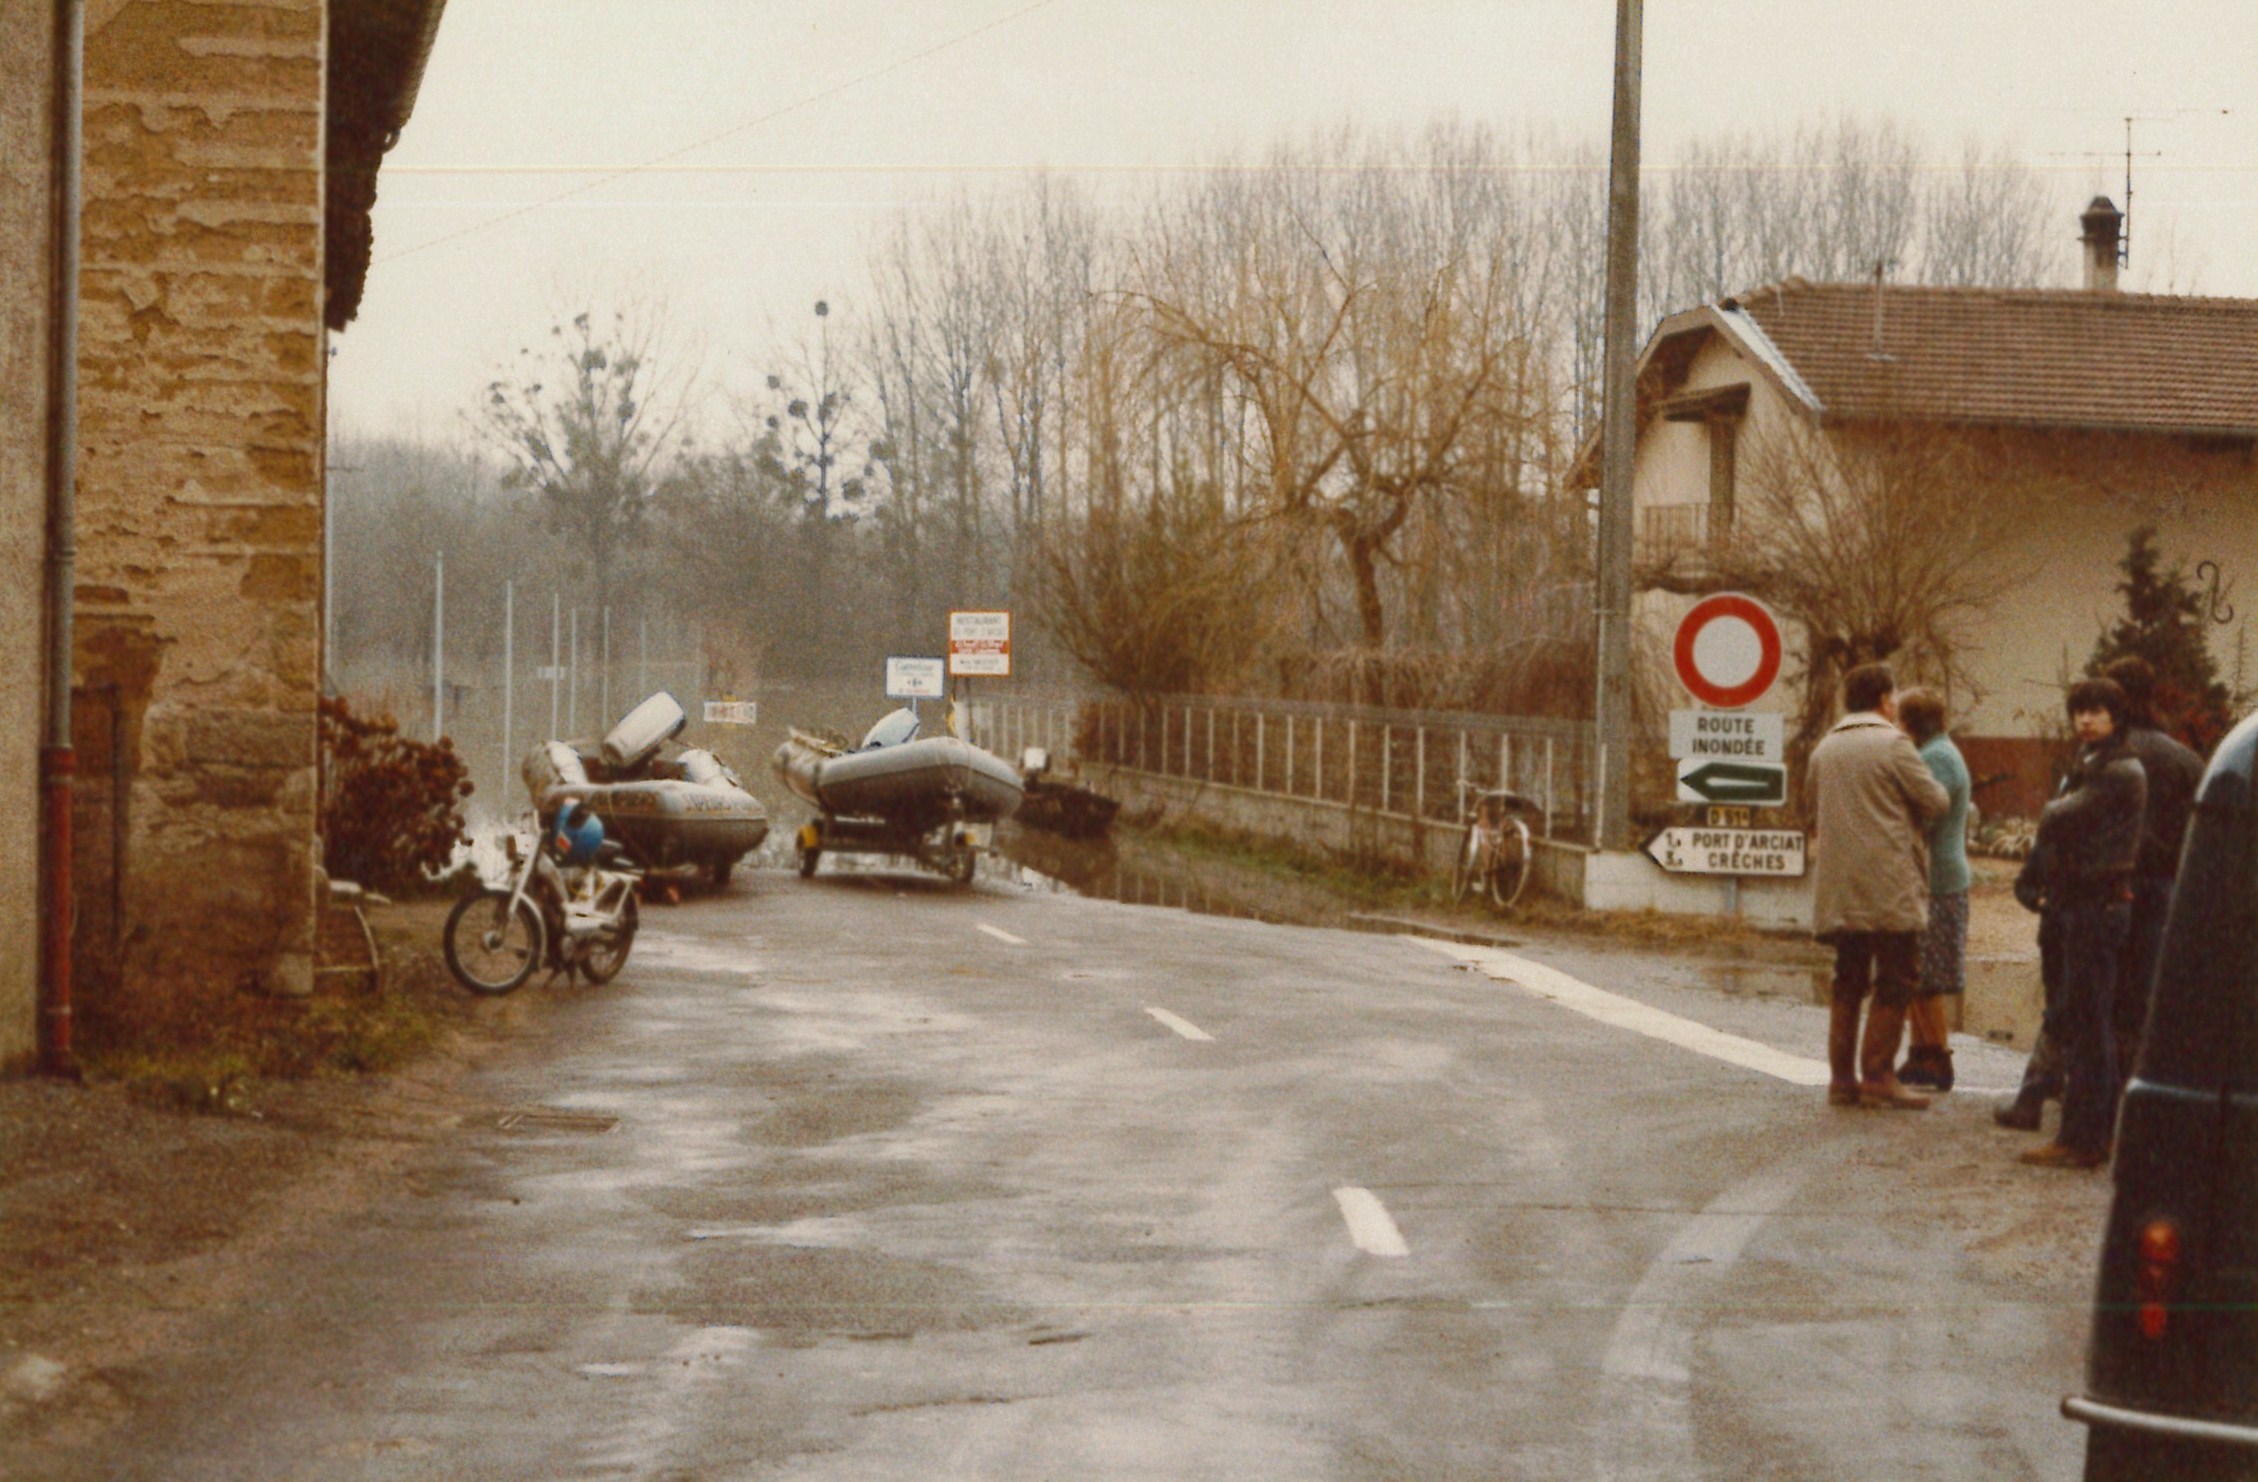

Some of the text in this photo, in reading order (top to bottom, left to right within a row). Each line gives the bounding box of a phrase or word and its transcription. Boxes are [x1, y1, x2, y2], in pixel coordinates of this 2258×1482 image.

[1697, 717, 1754, 734] ROUTE
[1692, 738, 1765, 755] INONDÉE
[1711, 809, 1719, 825] D
[1693, 832, 1730, 848] PORT
[1735, 833, 1803, 851] D'ARCIAT
